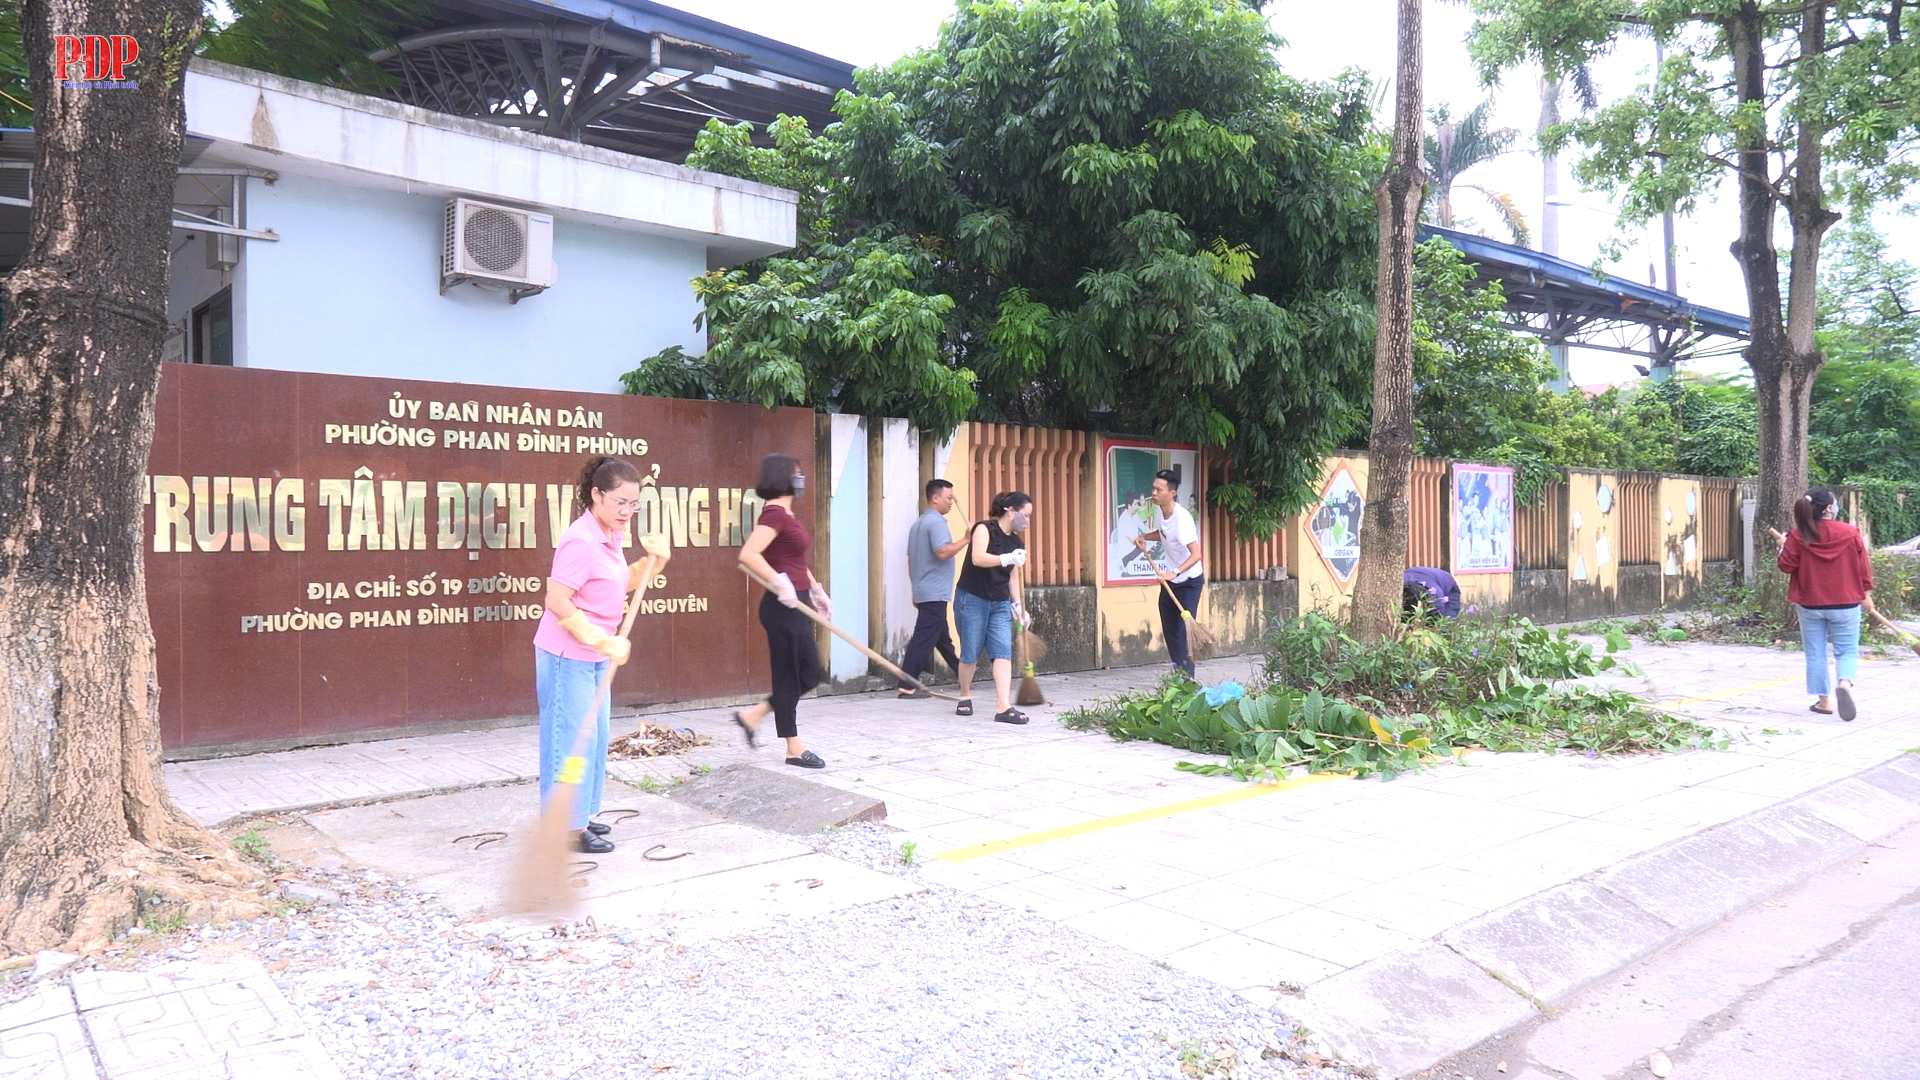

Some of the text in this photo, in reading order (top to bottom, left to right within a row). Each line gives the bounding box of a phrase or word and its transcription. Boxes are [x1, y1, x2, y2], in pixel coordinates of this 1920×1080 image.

[389, 391, 422, 420] ỦY
[486, 402, 551, 427] NHÂN
[557, 406, 603, 429] DÂN
[325, 419, 648, 456] PHƯỜNG PHAN ĐÌNH PHÙNG
[319, 466, 427, 550] TÂM
[437, 481, 537, 560] DỊCH
[307, 582, 350, 604] ĐỊA
[355, 575, 401, 597] CHỈ:
[406, 571, 437, 596] SỐ
[441, 579, 463, 595] 19
[467, 572, 541, 594] ĐƯỜNG
[241, 607, 343, 633] PHƯỜNG
[350, 610, 411, 628] PHAN
[417, 602, 468, 625] ĐÌNH
[473, 600, 543, 622] PHÙNG
[641, 594, 708, 614] NGUYÊN
